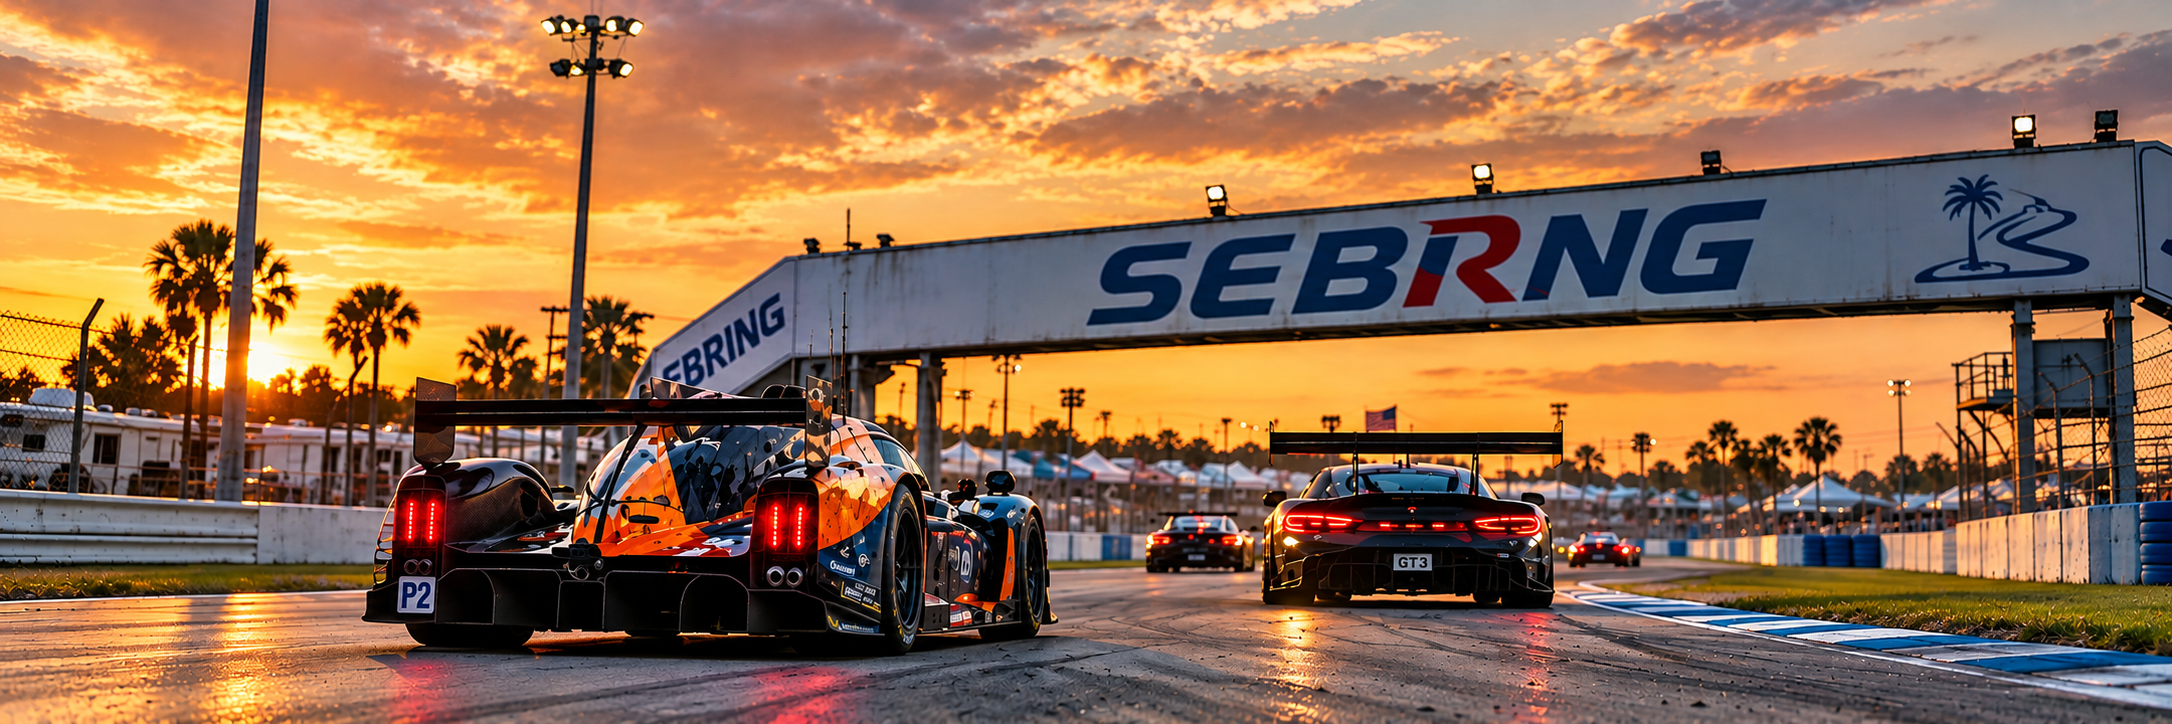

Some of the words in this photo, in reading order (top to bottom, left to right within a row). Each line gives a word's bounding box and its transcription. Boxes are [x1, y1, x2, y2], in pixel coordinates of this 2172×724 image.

[1086, 199, 1768, 326] SEBRNG
[662, 292, 786, 387] EBRING
[1398, 556, 1428, 569] GT3
[401, 581, 431, 609] P2
